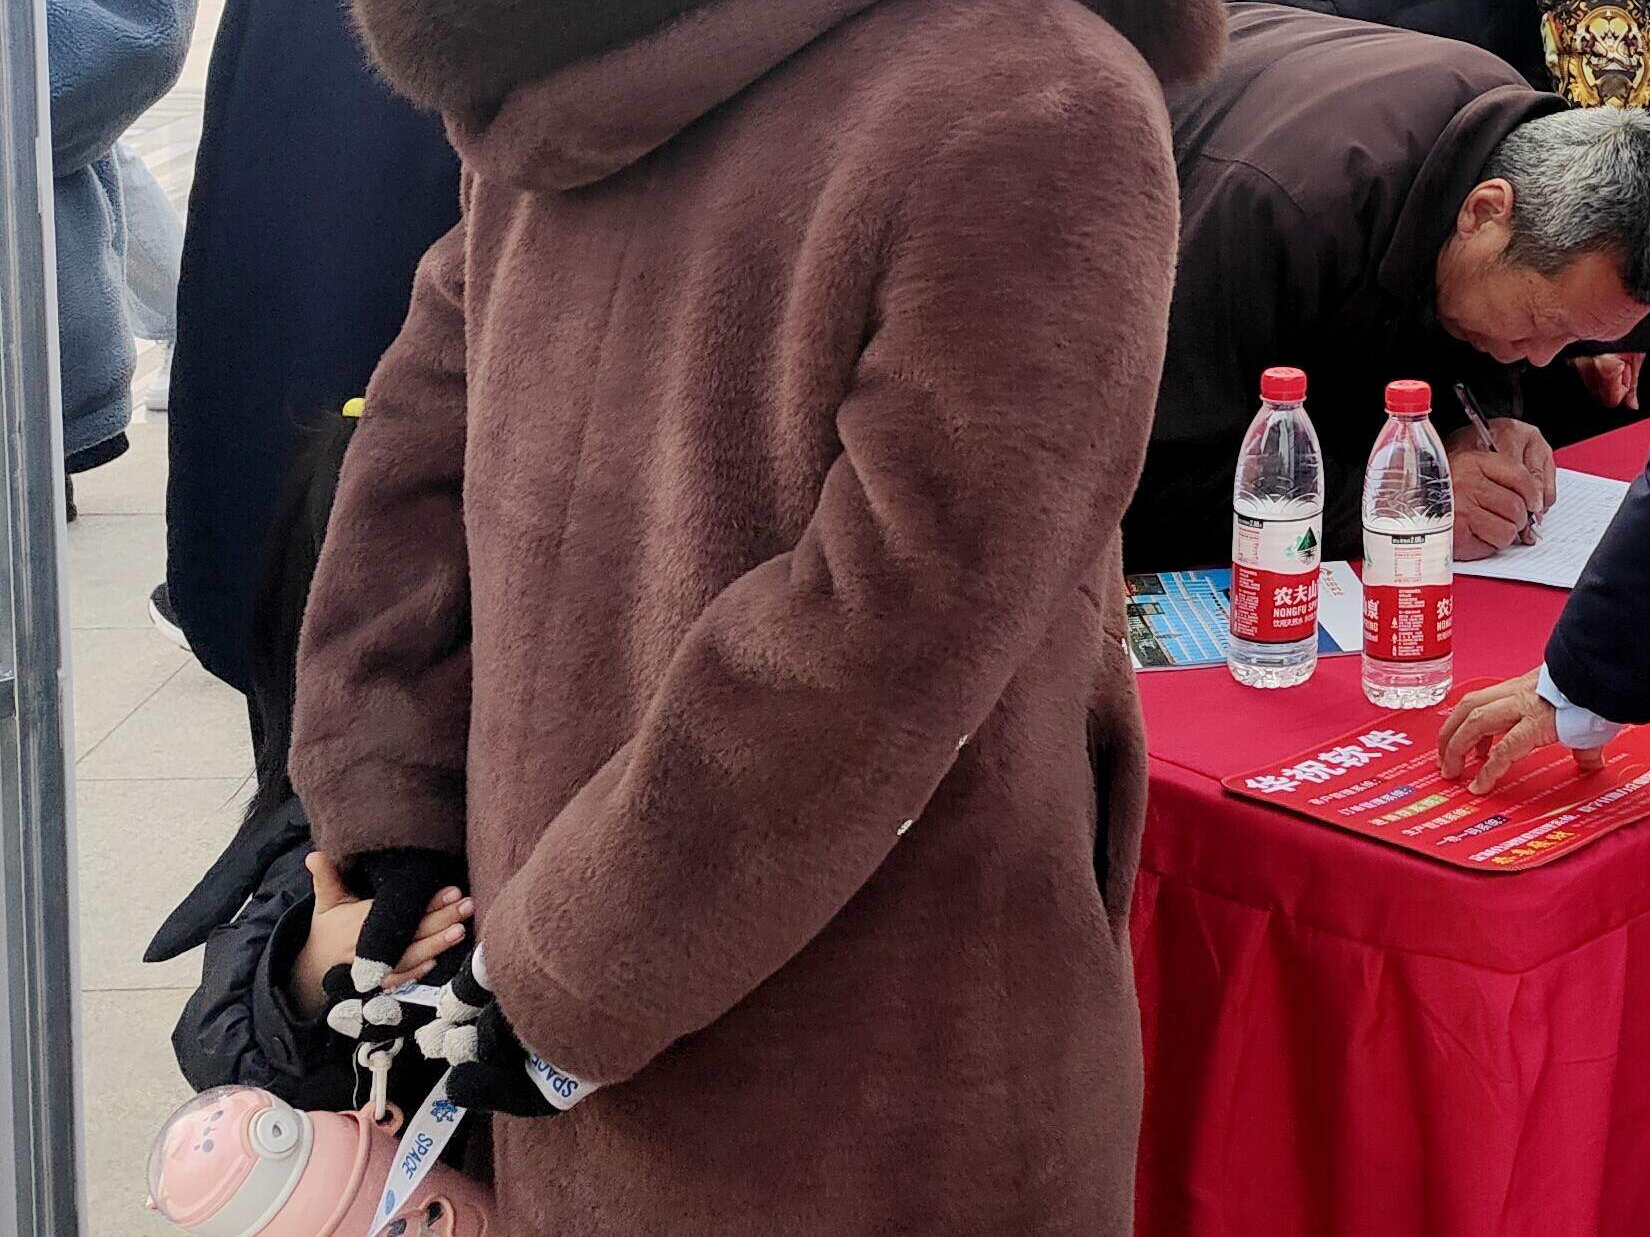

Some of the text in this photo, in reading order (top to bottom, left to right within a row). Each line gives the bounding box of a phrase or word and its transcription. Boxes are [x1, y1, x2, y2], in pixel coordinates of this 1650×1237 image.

[1273, 604, 1307, 618] NONGFU
[1245, 729, 1413, 794] 华祝软件
[401, 1132, 434, 1180] SPACE
